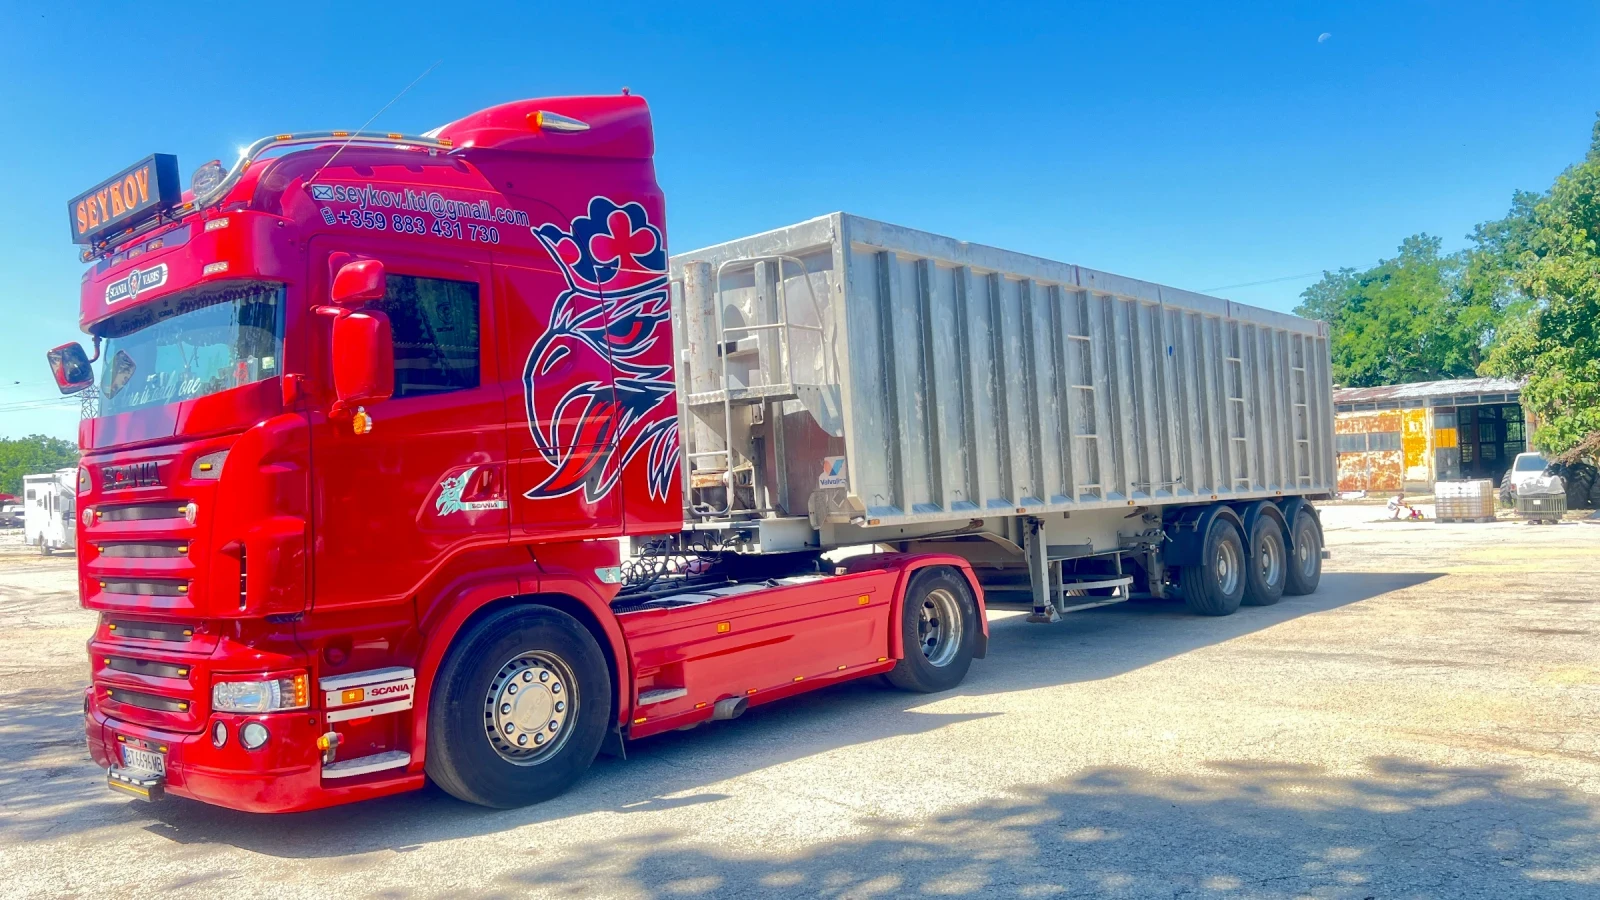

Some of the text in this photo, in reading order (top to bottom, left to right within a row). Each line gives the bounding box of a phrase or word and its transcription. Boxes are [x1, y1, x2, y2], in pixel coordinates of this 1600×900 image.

[76, 165, 149, 234] SEYKOV
[334, 184, 530, 227] seykov.ltd@gmail.com
[337, 210, 499, 244] +359 883 431 730
[109, 270, 160, 298] SCANIA VABIS
[178, 377, 201, 396] one
[102, 461, 162, 490] SCANIA
[371, 683, 410, 697] SCANIA
